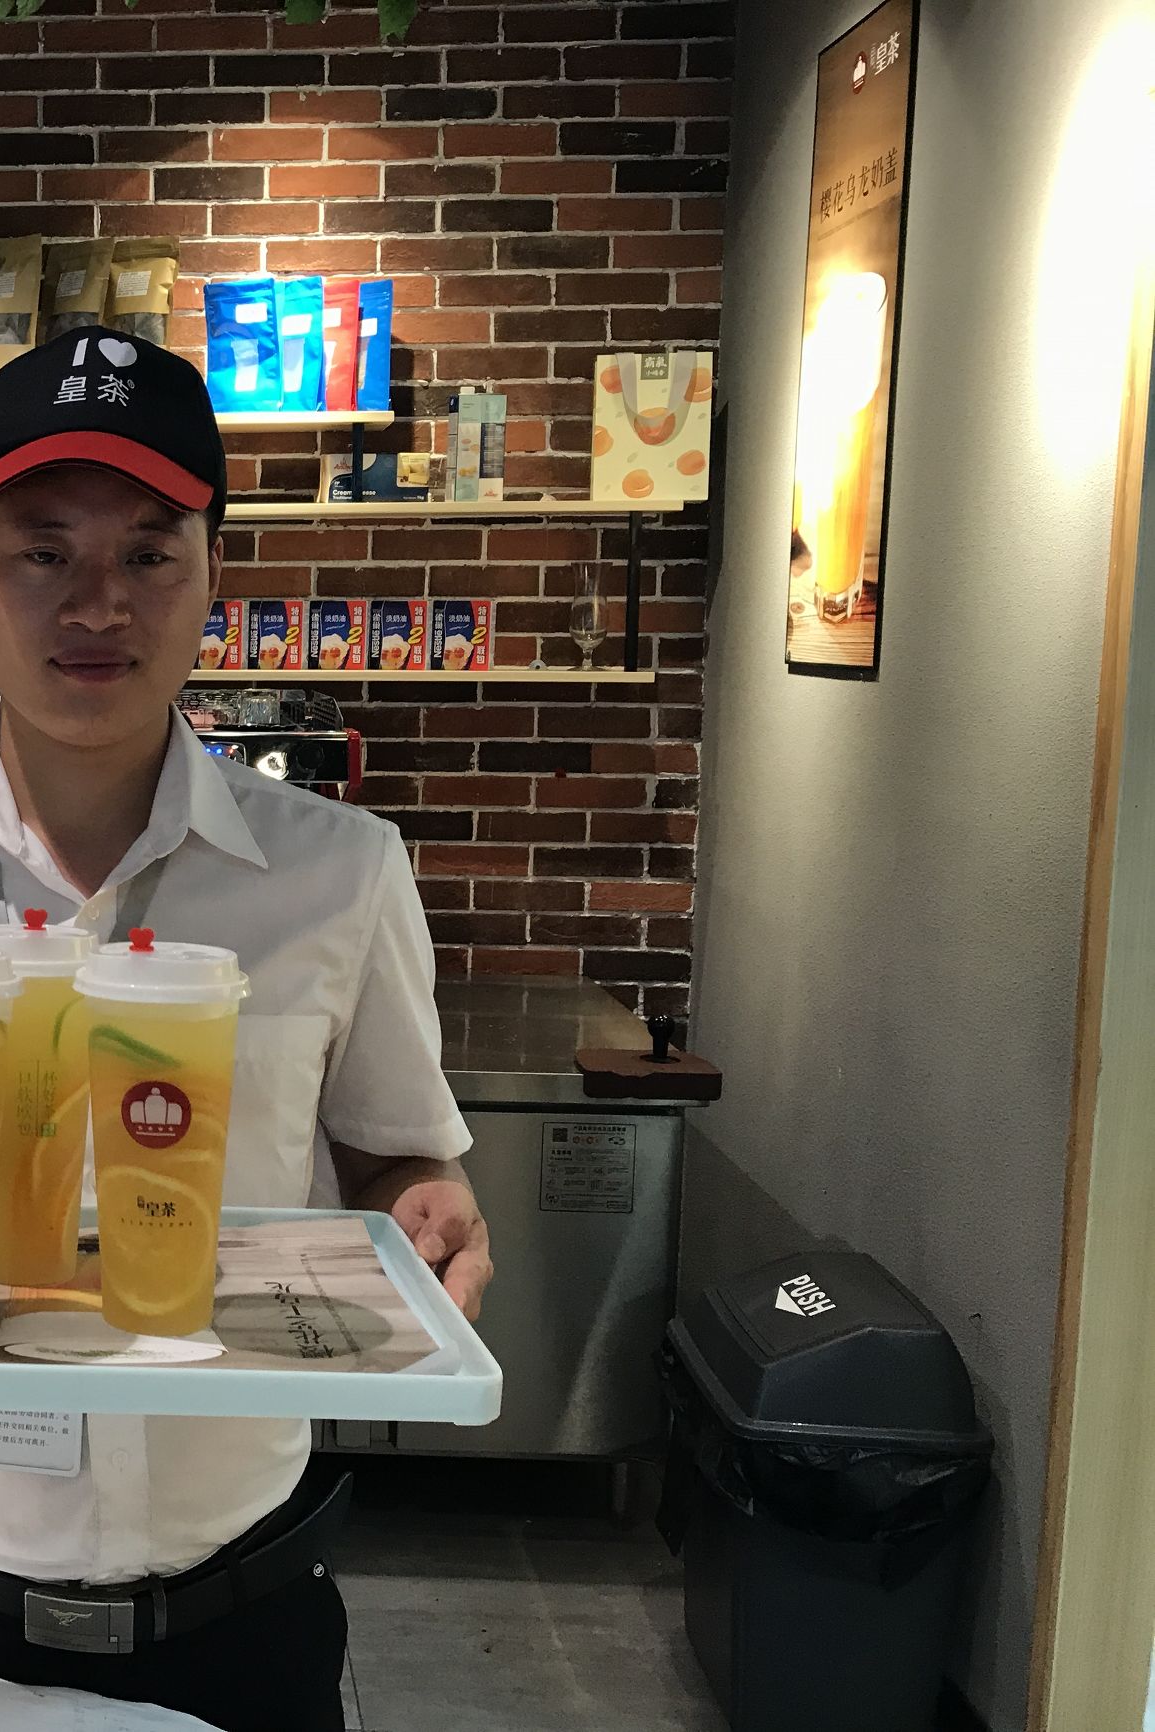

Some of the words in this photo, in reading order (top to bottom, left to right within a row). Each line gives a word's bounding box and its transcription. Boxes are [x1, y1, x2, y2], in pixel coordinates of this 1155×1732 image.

[875, 31, 901, 75] 皇茶
[820, 147, 898, 224] 樱花乌龙奶盖
[53, 374, 130, 407] 皇茶
[782, 1274, 837, 1316] PUSH
